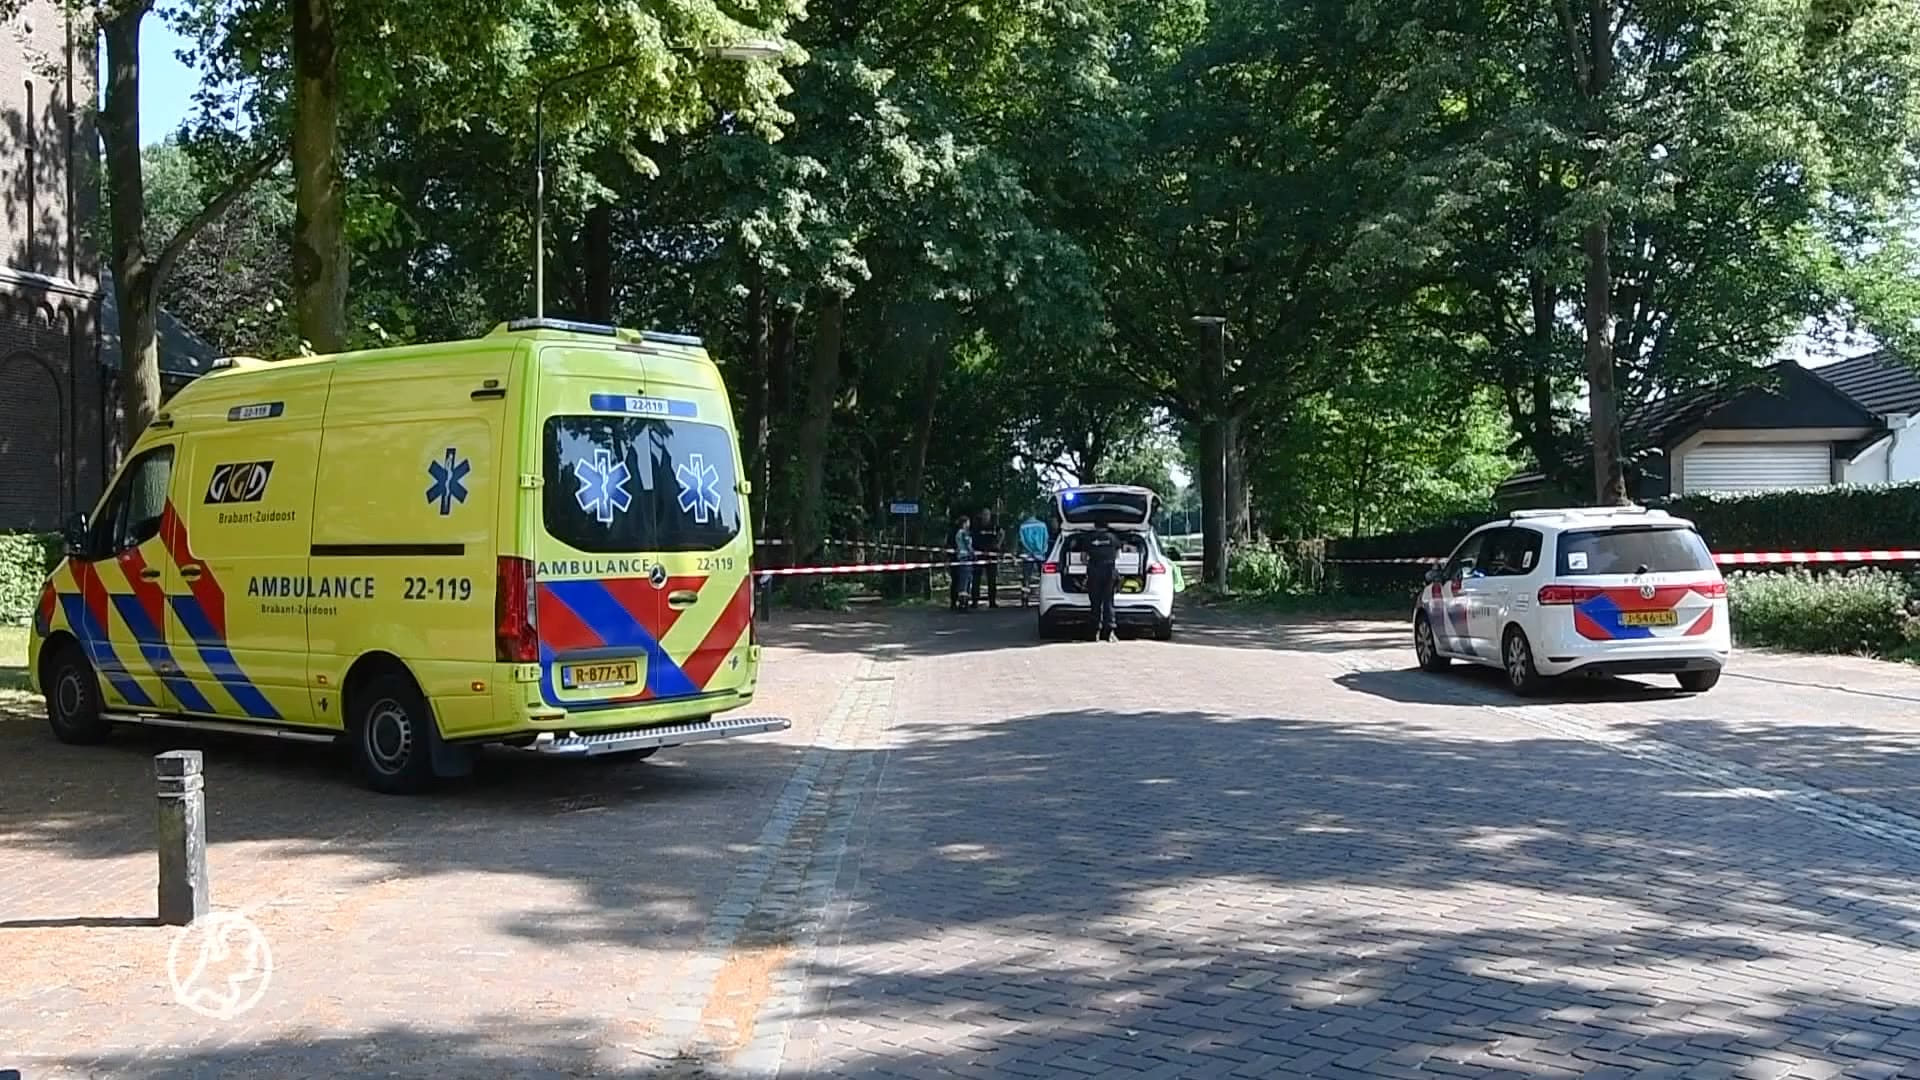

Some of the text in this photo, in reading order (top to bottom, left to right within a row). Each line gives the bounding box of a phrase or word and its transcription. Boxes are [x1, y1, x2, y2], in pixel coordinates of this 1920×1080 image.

[632, 399, 664, 411] 22-119
[208, 464, 268, 501] GGD
[218, 510, 296, 525] Brabant-Zuidoost
[536, 558, 650, 575] AMBULANCE
[696, 557, 734, 571] 22-119
[248, 576, 375, 599] AMBULANCE
[403, 577, 472, 601] 22-119
[261, 603, 337, 616] Brabant-Zuidoost
